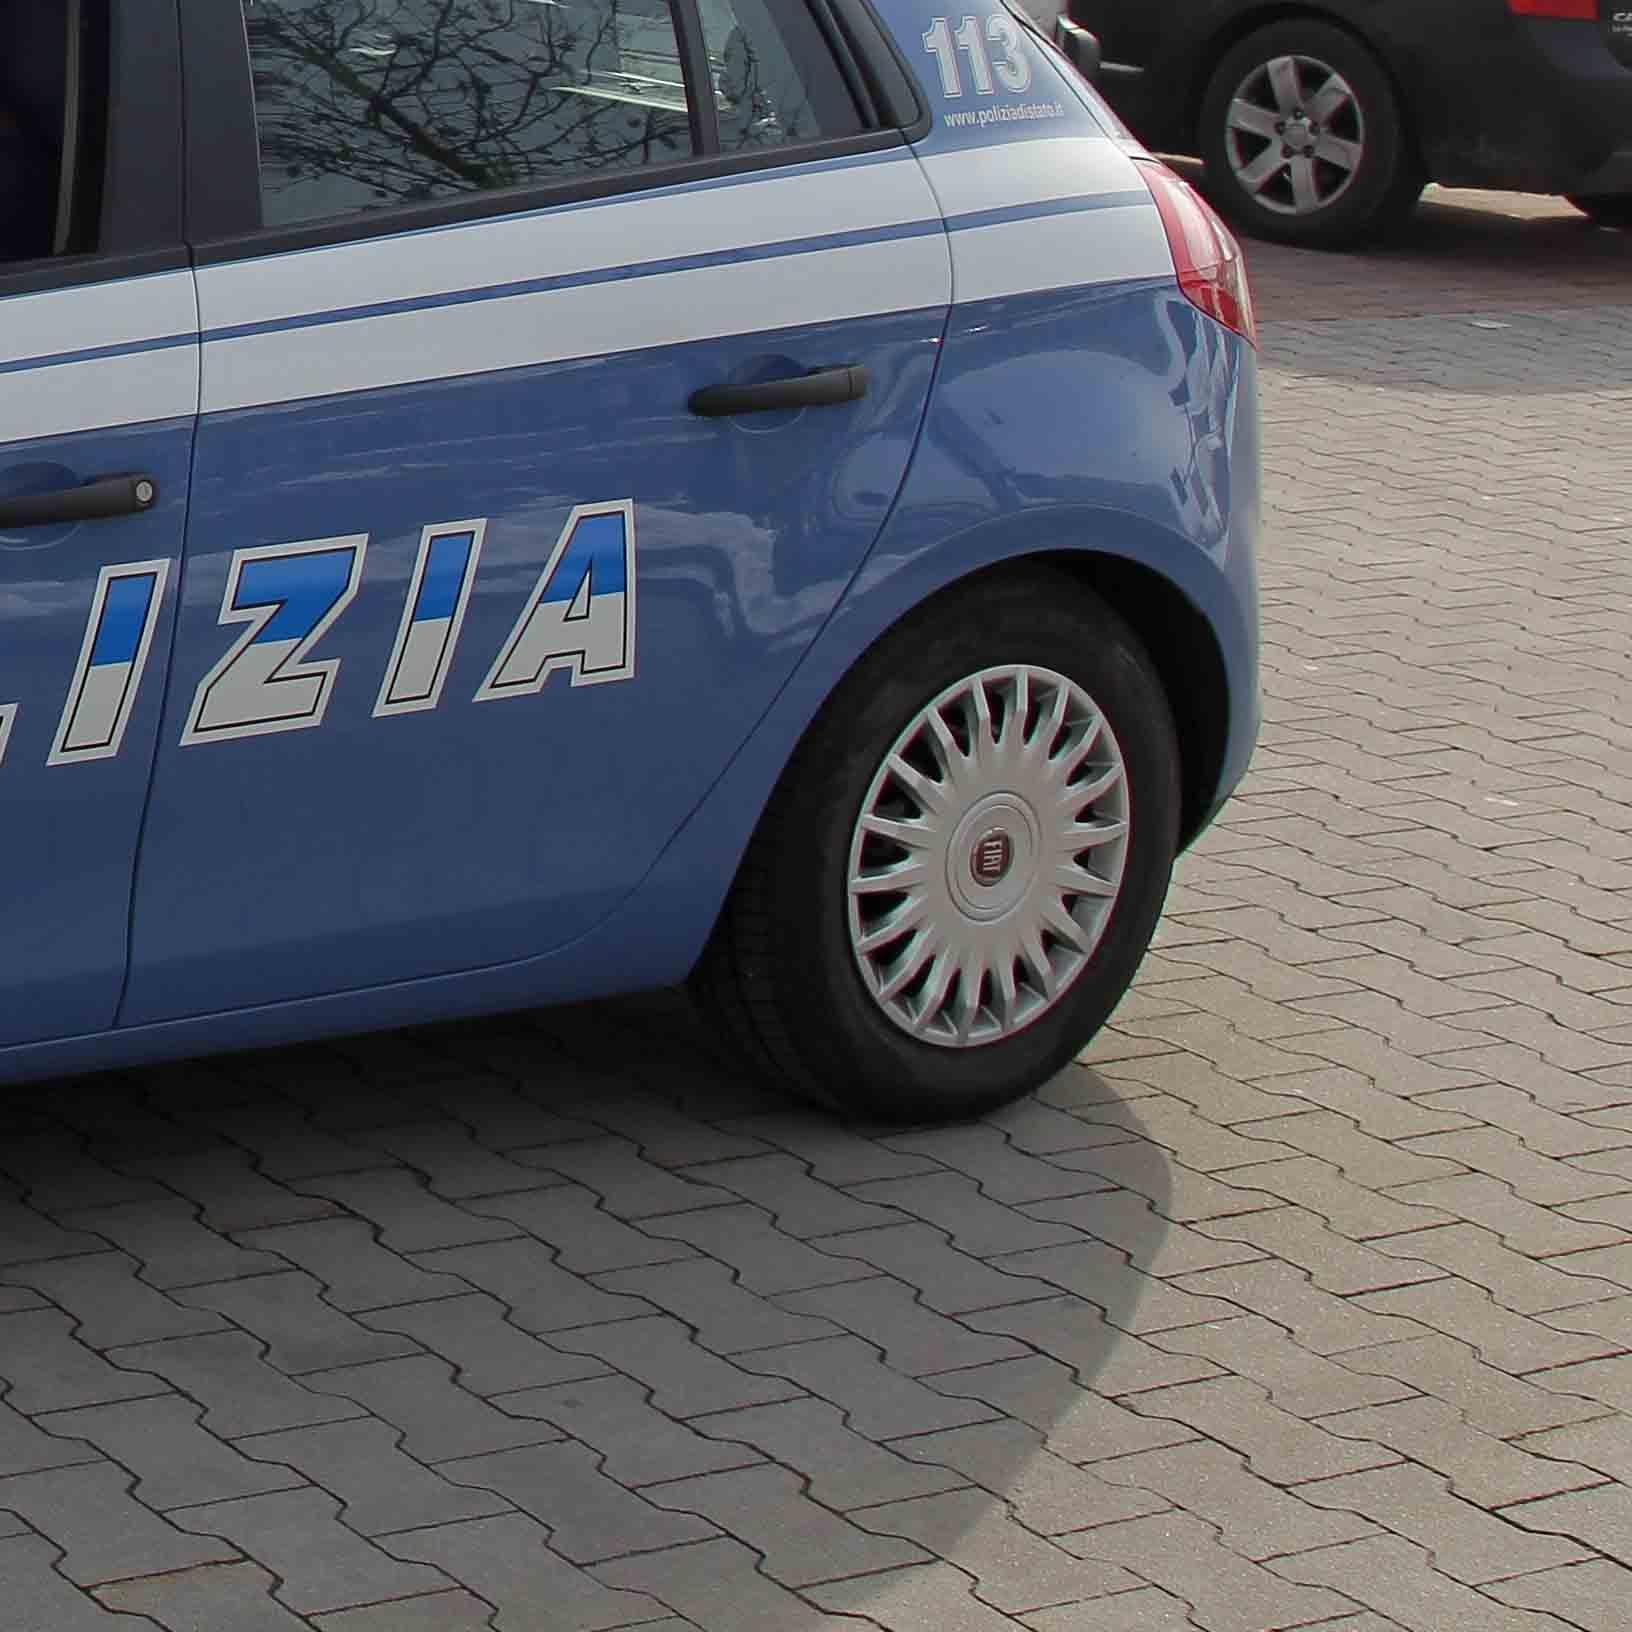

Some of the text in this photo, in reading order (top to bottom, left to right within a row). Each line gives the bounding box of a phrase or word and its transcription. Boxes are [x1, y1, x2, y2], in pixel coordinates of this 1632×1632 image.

[922, 14, 1032, 99] 113
[943, 101, 1065, 128] www.poliziadistato.it
[983, 839, 1003, 872] FIAT
